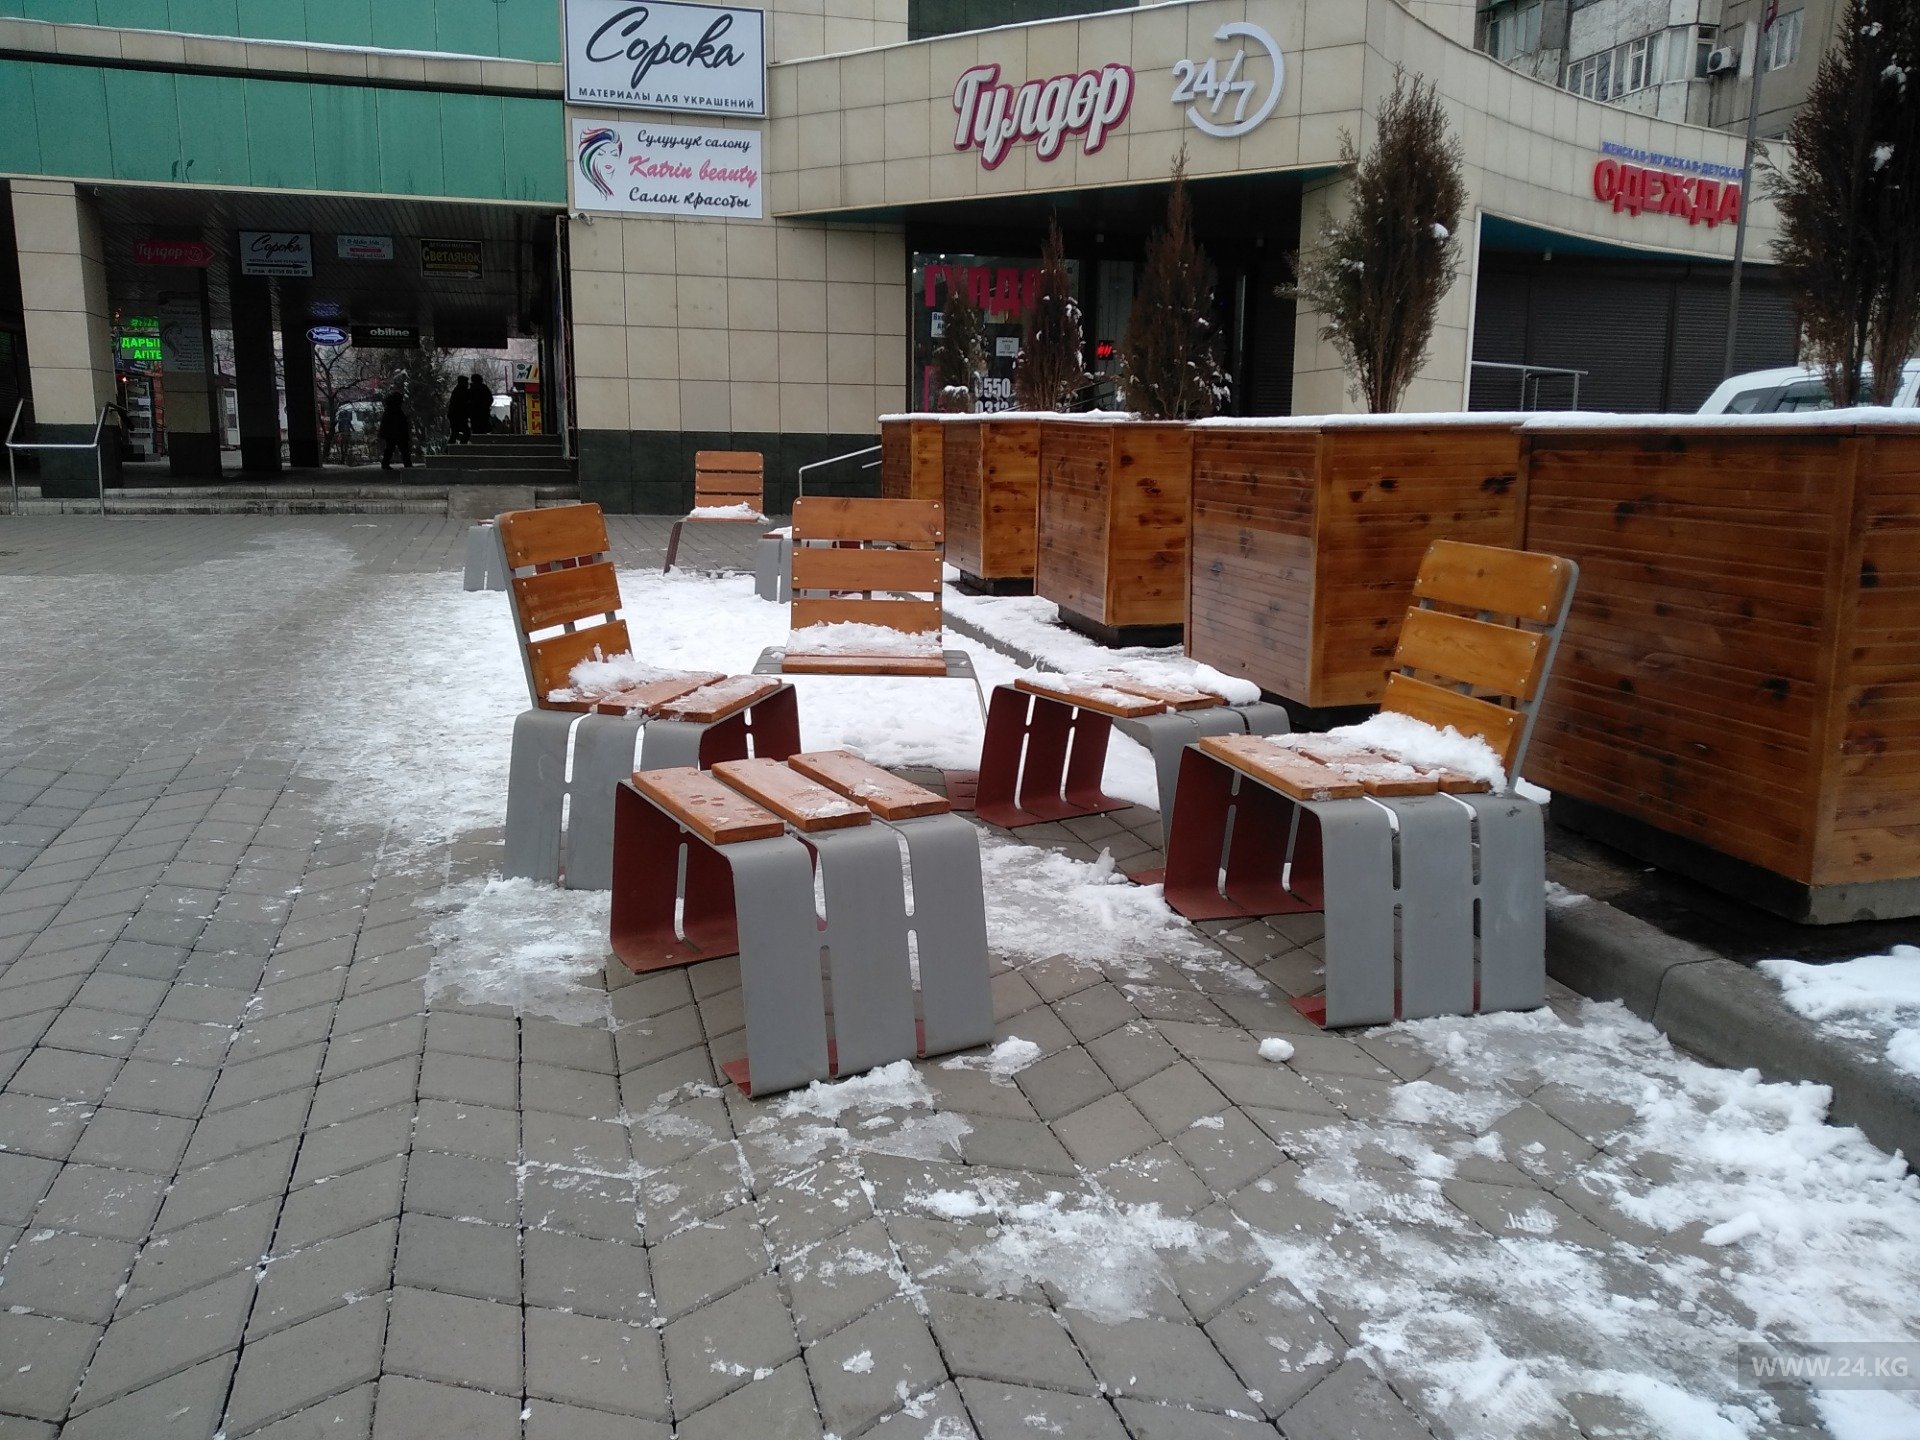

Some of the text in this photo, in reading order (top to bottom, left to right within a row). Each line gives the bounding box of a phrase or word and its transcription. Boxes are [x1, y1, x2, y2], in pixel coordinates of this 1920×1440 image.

[586, 6, 745, 89] Сорока
[578, 87, 754, 109] МАТЕРИАЛЫ ДЛЯ УКРАШЕНИЙ
[637, 130, 751, 152] Сулуулук салону
[628, 155, 757, 188] Katrin beauty
[629, 187, 751, 209] Салон красоты
[1594, 159, 1742, 228] ОДЕЖДА
[251, 234, 303, 259] Сорока
